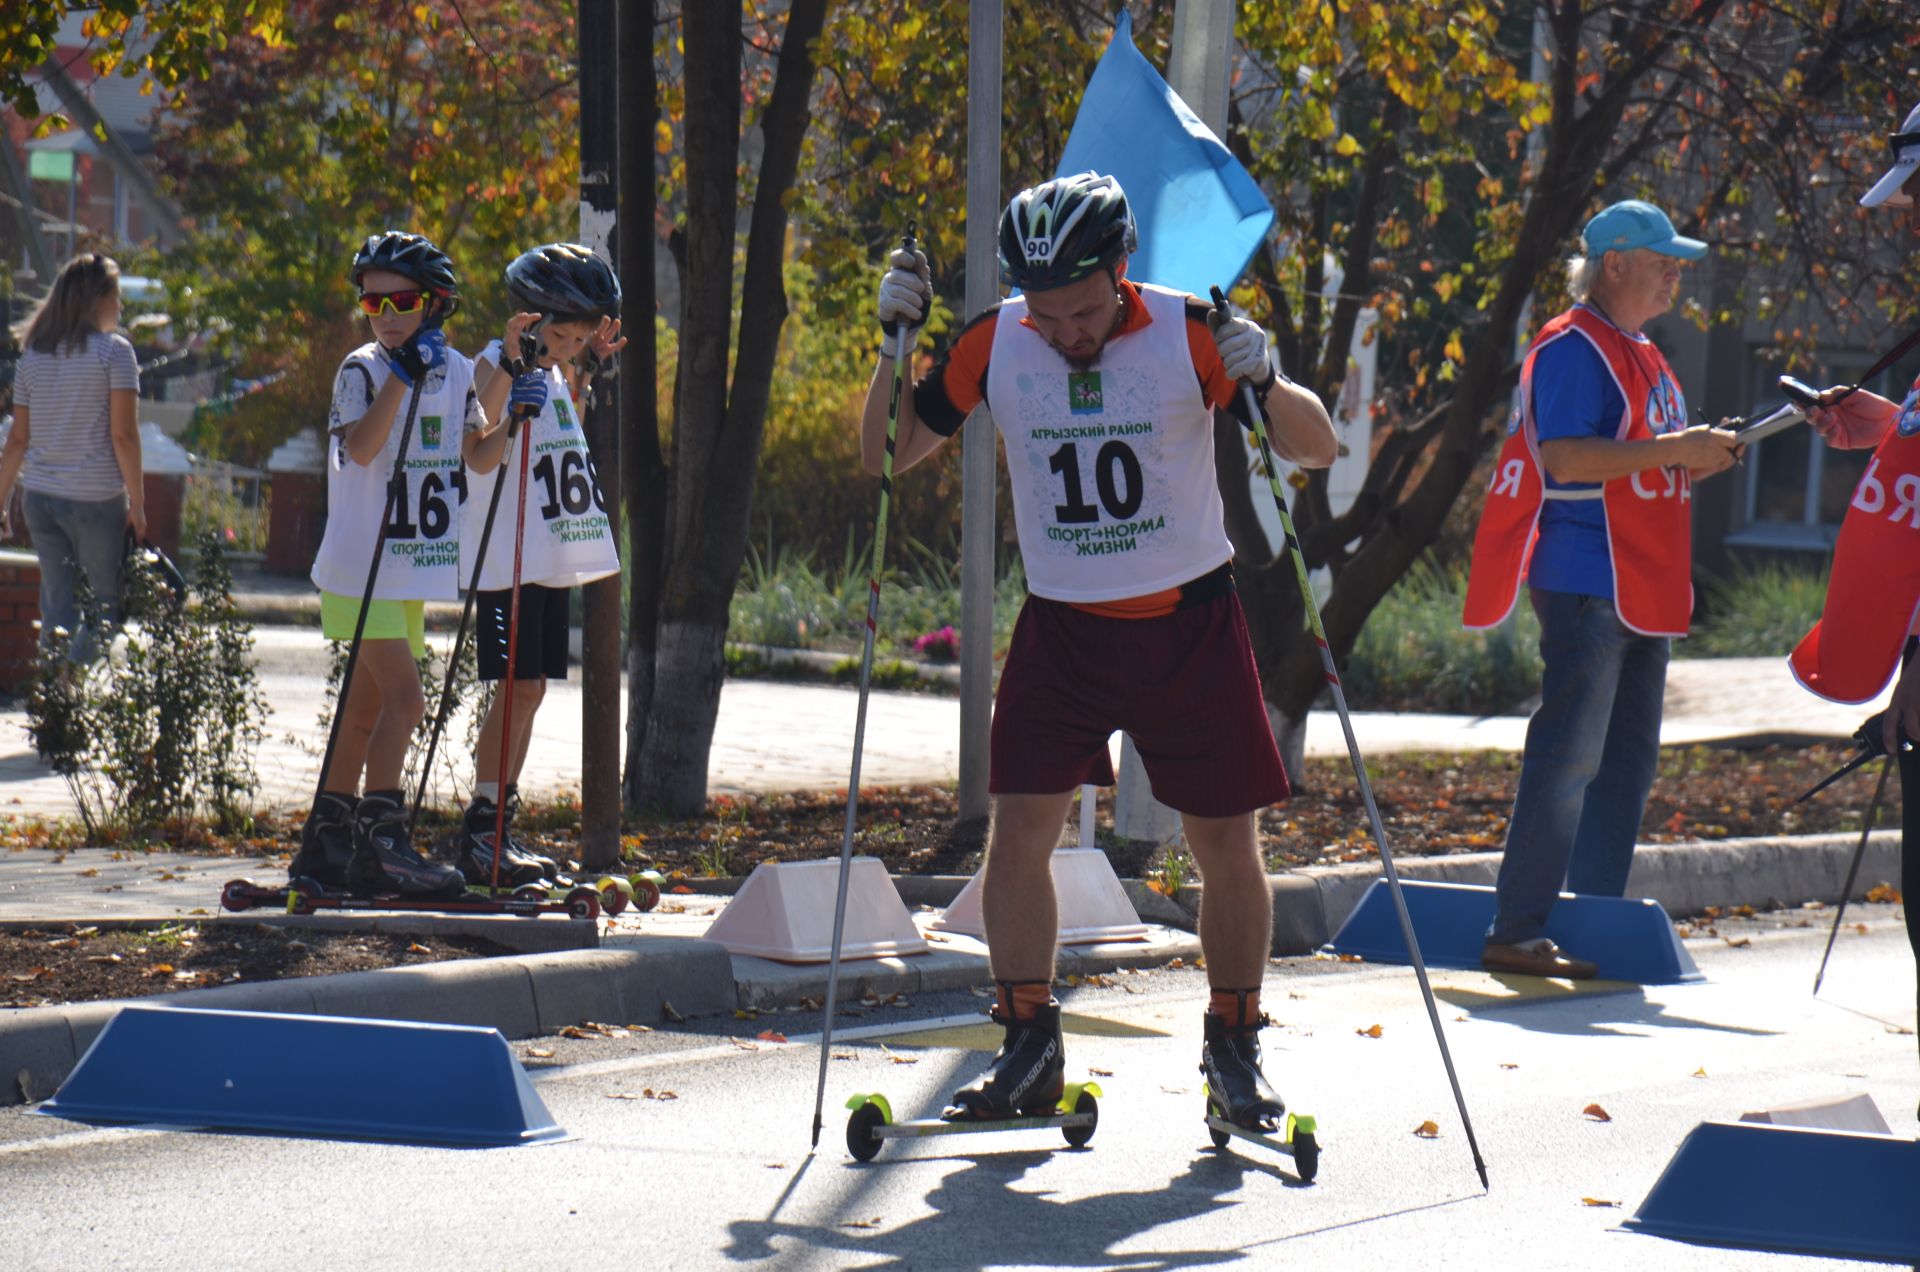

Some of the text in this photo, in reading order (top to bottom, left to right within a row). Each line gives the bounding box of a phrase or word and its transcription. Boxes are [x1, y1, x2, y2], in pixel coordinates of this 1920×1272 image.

[1027, 241, 1050, 257] 90
[1031, 421, 1152, 440] АГРЫЗСКИЙ РАЙОН
[533, 450, 608, 520] 168
[1049, 440, 1144, 523] 10
[560, 528, 604, 543] ЖИЗНИ
[1076, 537, 1137, 556] ЖИЗНИ
